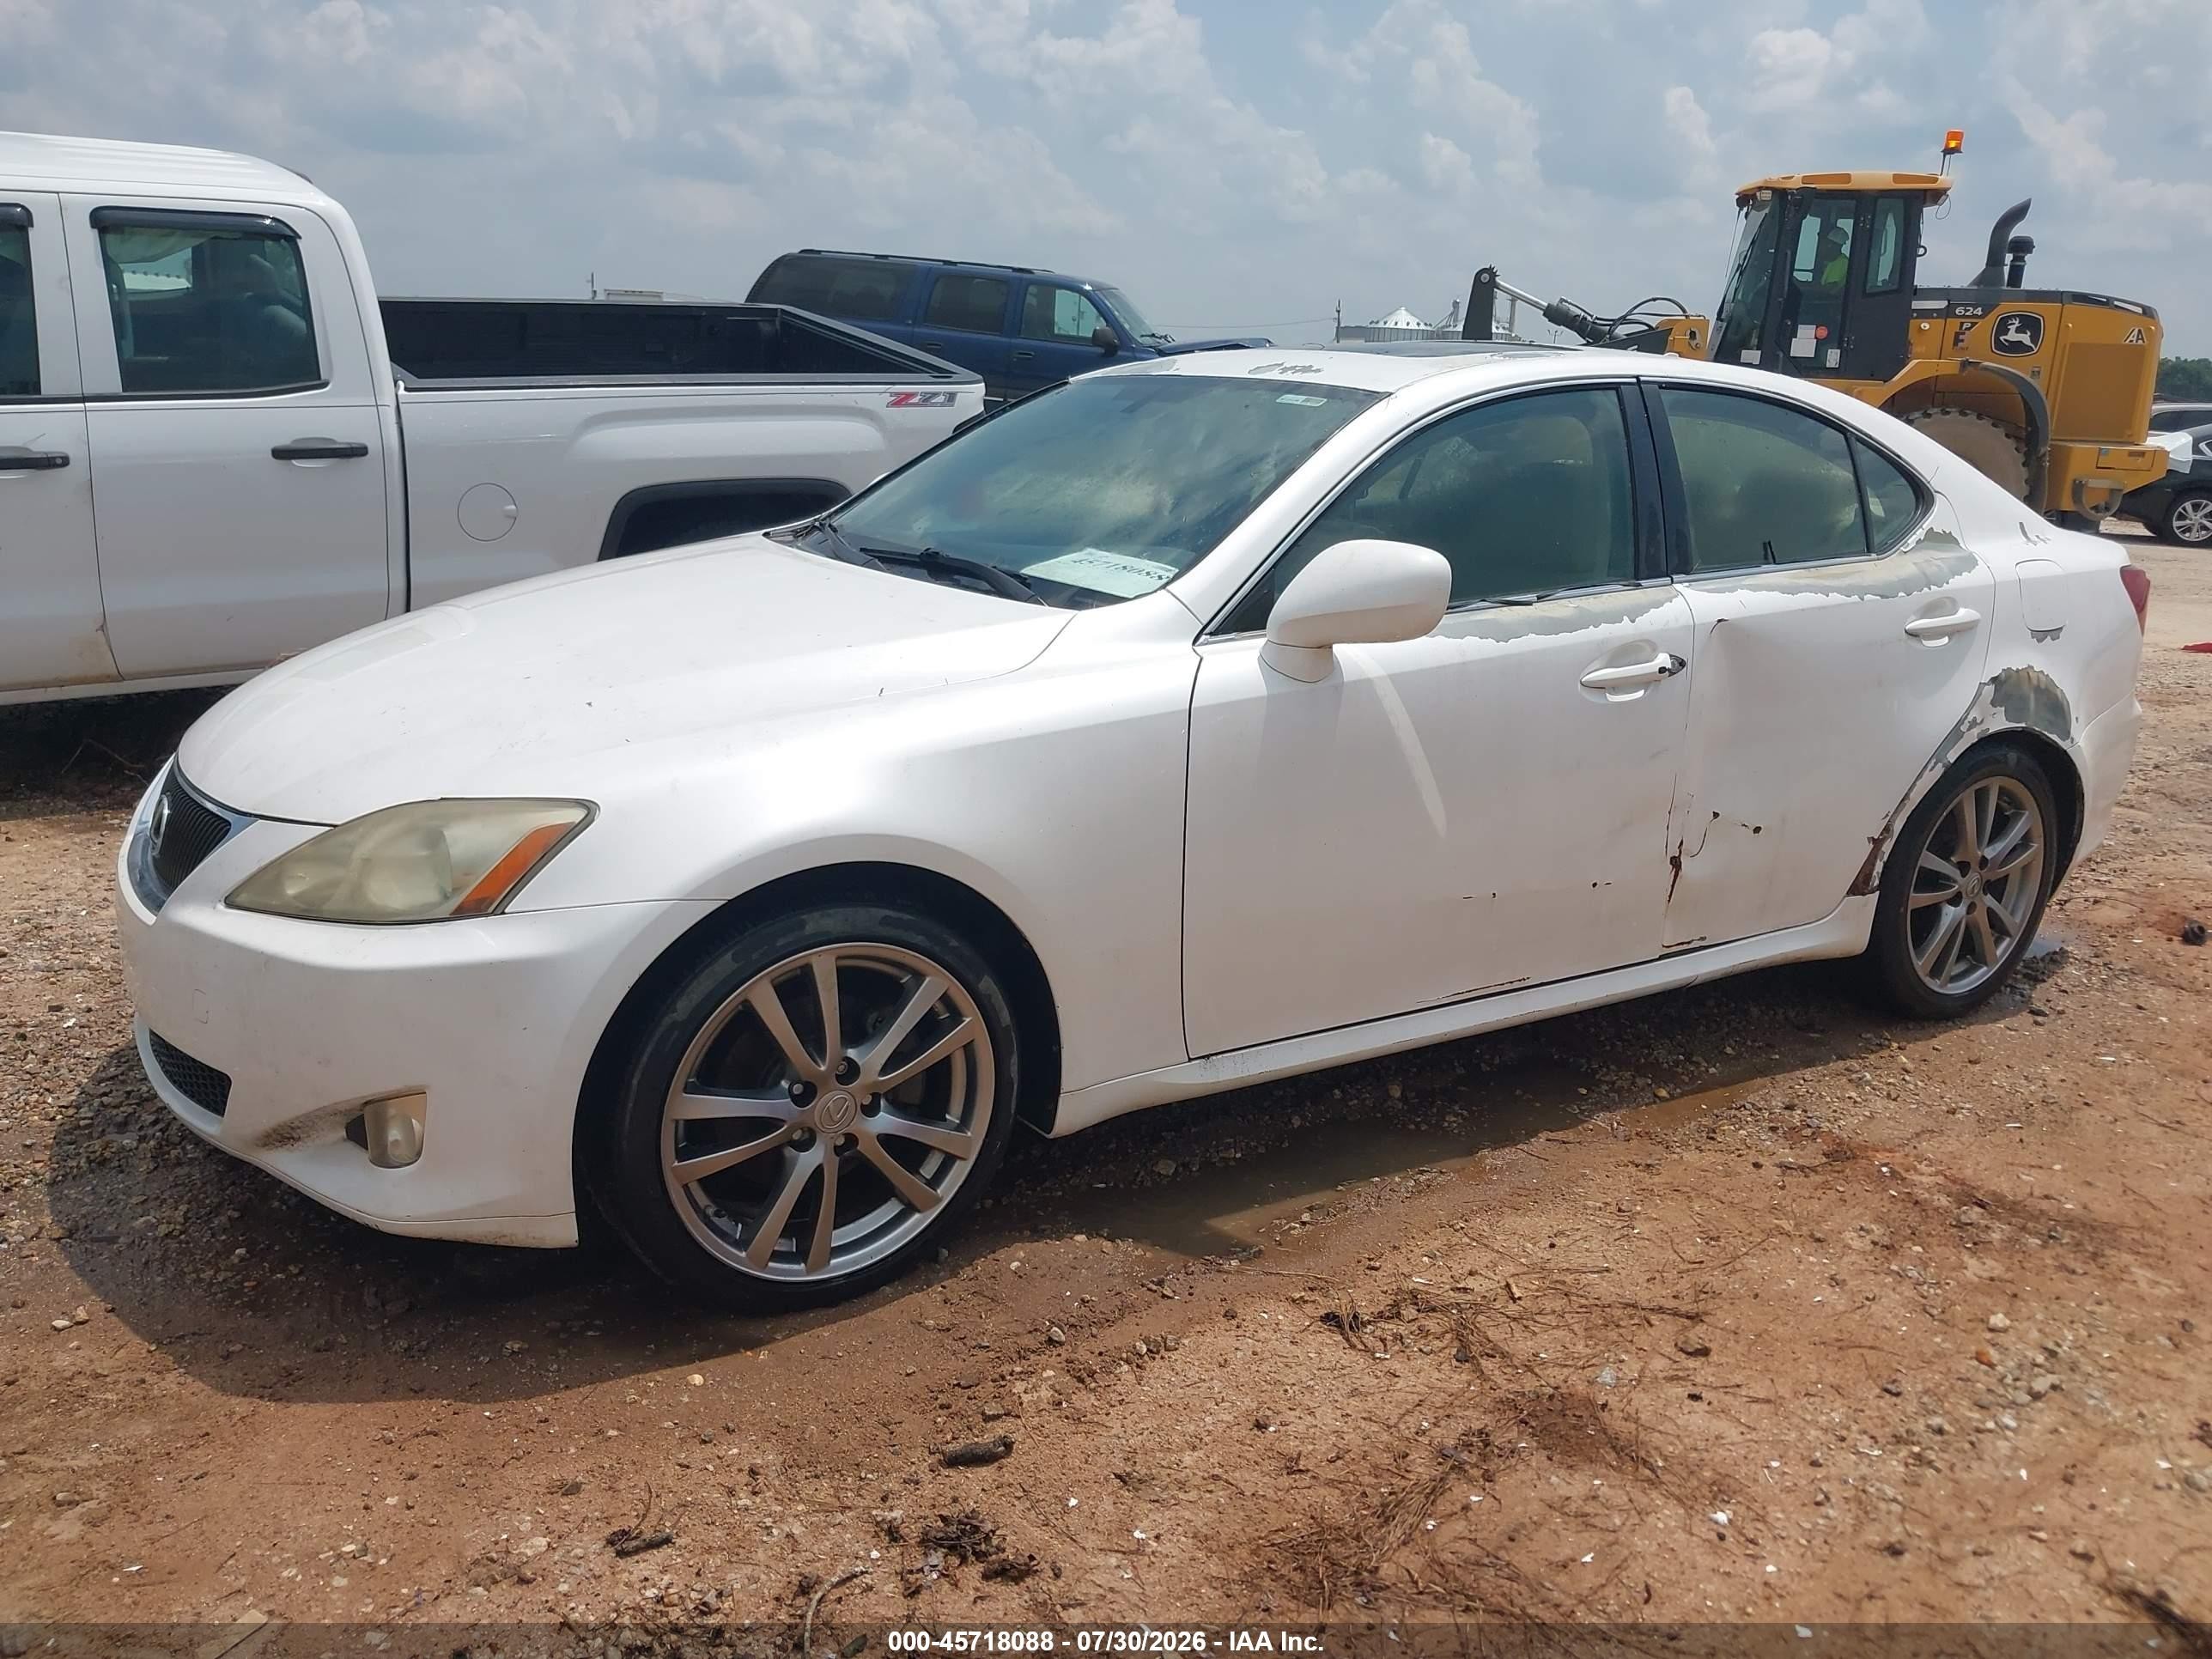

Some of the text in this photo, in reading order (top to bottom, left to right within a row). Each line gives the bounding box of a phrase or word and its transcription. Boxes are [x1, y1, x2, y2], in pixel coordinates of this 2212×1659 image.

[1955, 307, 1983, 316] 624
[1962, 322, 1972, 331] P
[886, 391, 958, 408] Z71
